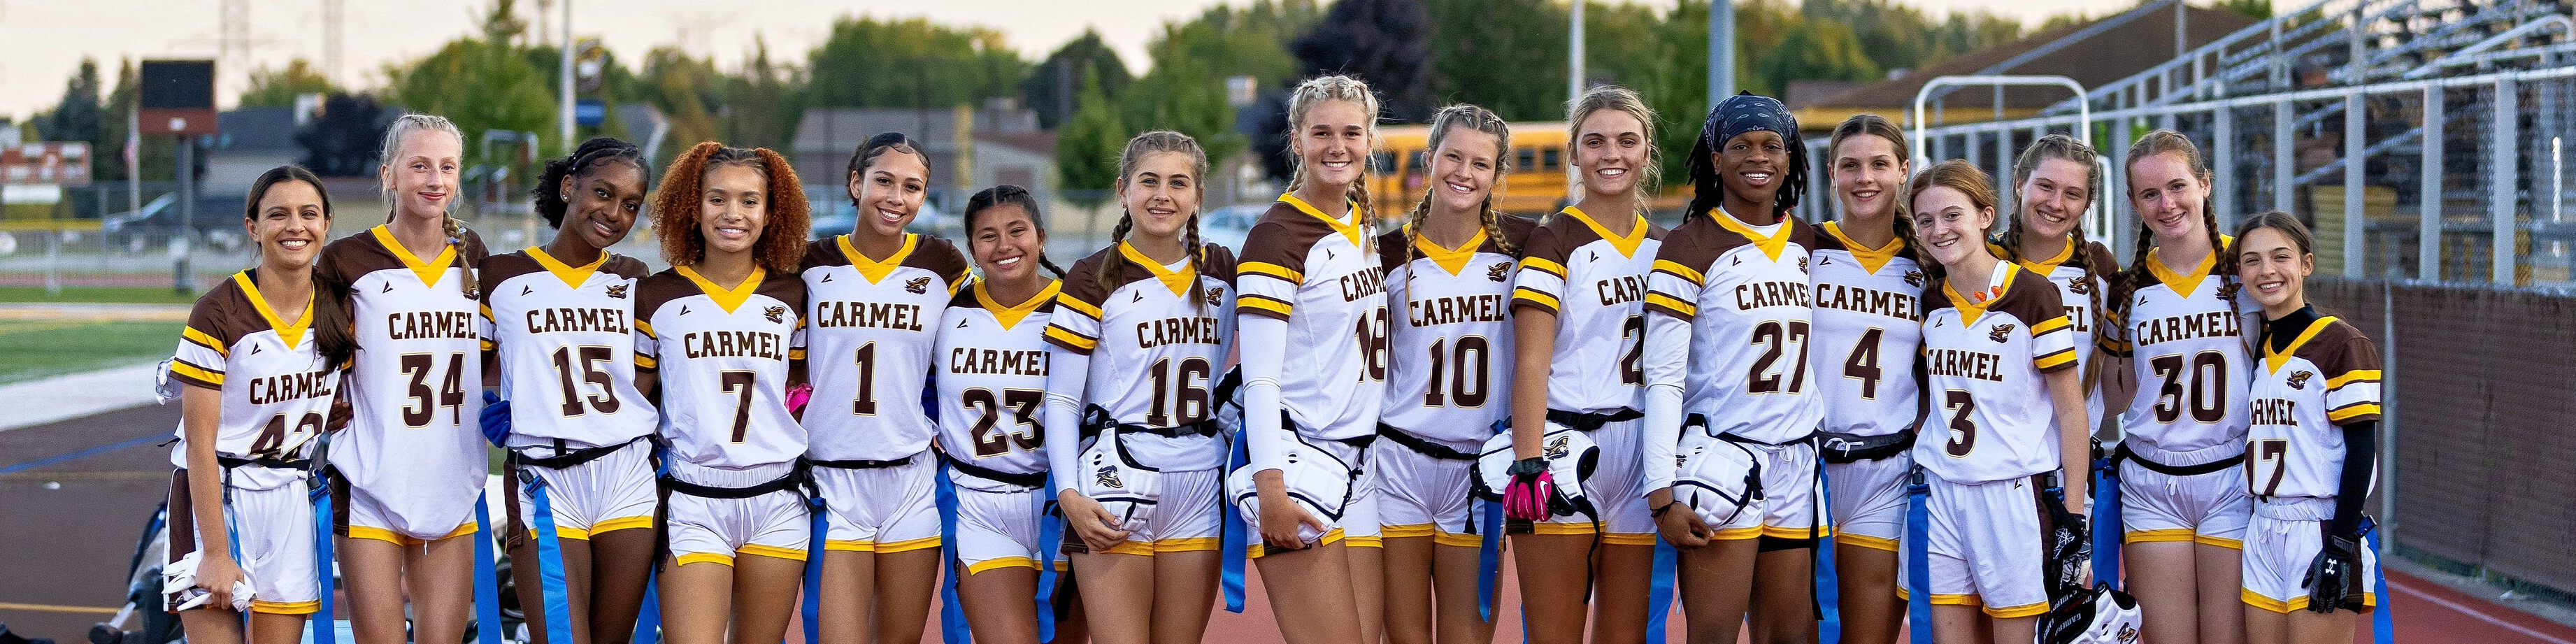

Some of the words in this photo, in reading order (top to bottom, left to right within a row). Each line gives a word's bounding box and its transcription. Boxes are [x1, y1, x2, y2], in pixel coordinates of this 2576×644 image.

[388, 311, 477, 340] CARMEL
[526, 308, 629, 335] CARMEL
[817, 301, 923, 332] CARMEL
[1136, 317, 1221, 349] CARMEL
[1408, 294, 1505, 327] CARMEL
[1816, 283, 1919, 322] CARMEL
[2137, 310, 2238, 347] CARMEL
[552, 344, 621, 417] 15
[684, 331, 784, 362] CARMEL
[852, 341, 878, 417] 1
[1354, 306, 1387, 384] 18
[1423, 334, 1491, 410] 10
[1747, 319, 1810, 395] 27
[1842, 327, 1884, 401] 4
[1928, 349, 2003, 382] CARMEL
[250, 370, 331, 405] CARMEL
[400, 351, 466, 429] 34
[720, 369, 757, 445] 7
[1145, 356, 1211, 429] 16
[2149, 350, 2228, 424] 30
[961, 387, 1045, 459] 23
[1945, 388, 1977, 459] 3
